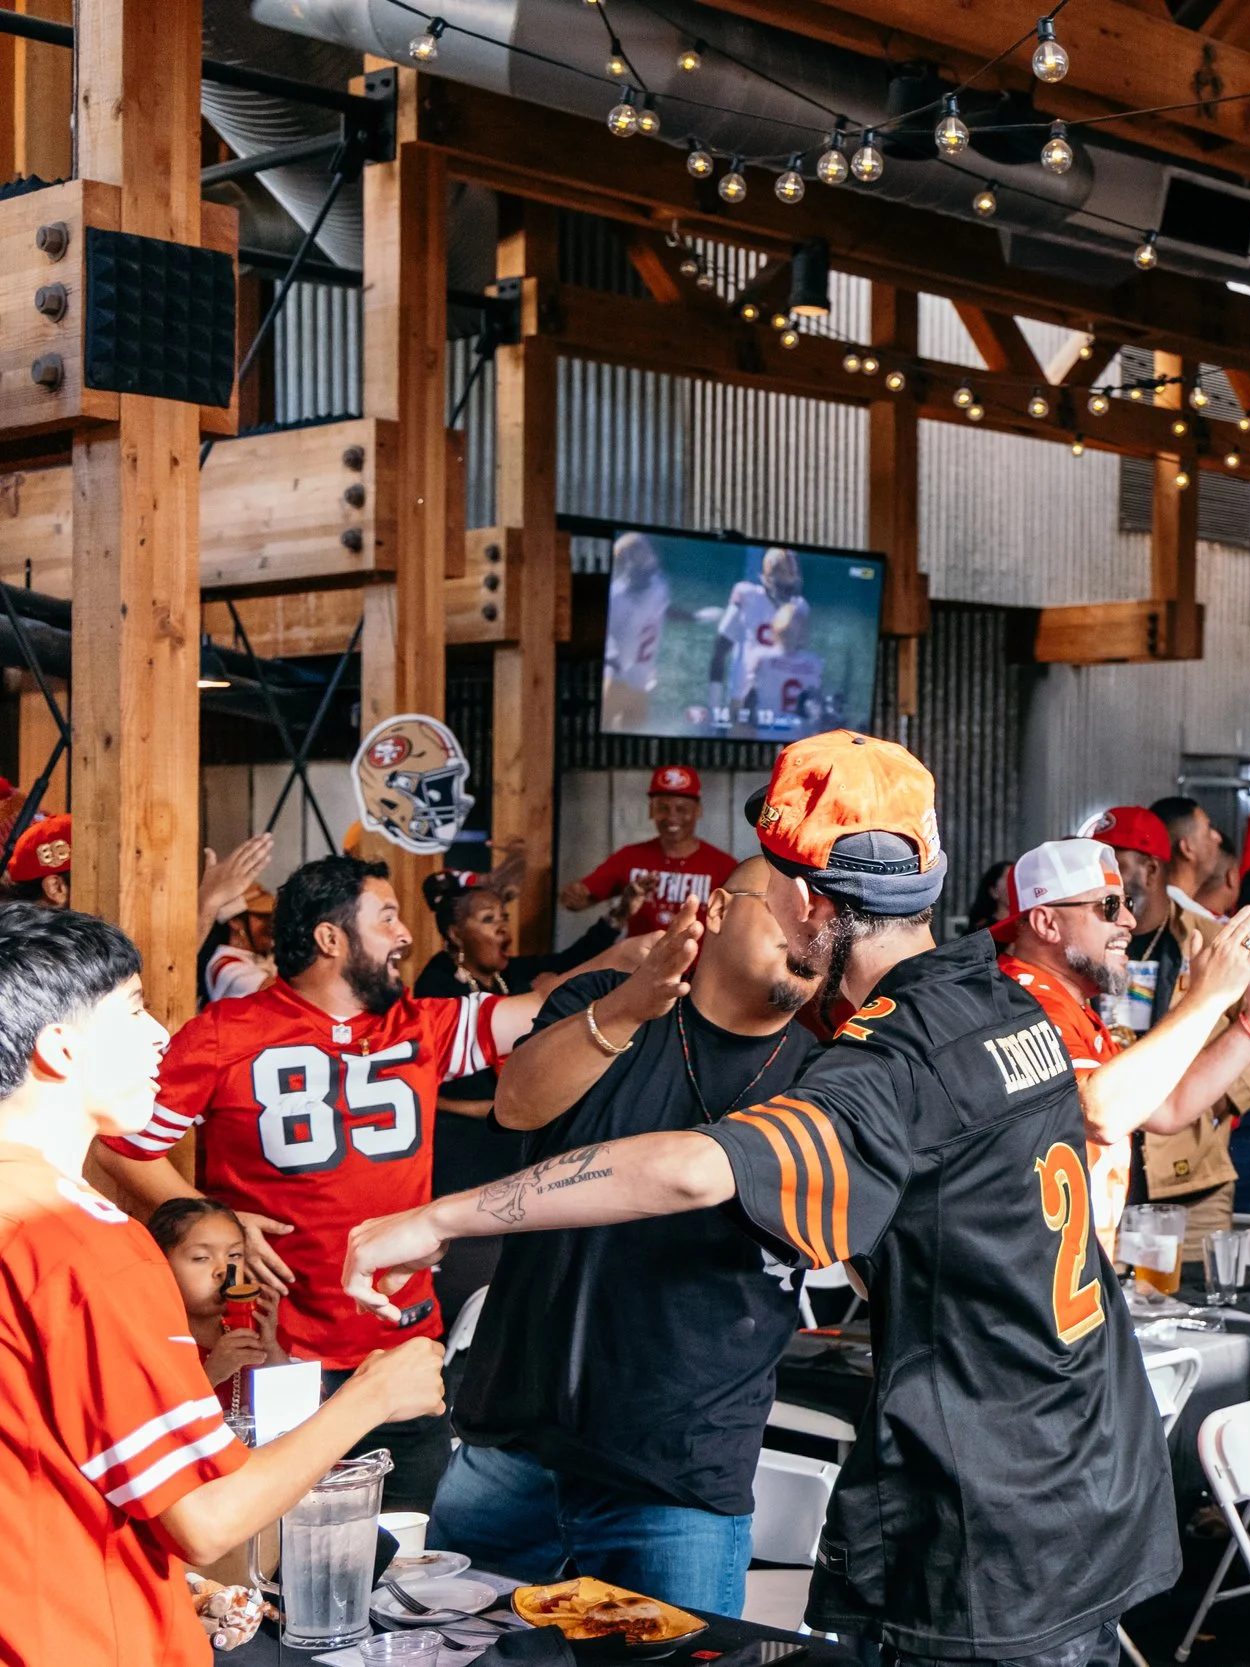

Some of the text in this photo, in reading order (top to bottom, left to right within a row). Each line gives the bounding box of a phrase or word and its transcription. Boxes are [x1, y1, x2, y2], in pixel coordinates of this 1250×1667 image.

[252, 1040, 421, 1176] 85
[983, 1019, 1069, 1095] LENOIR
[1033, 1141, 1106, 1346] 2
